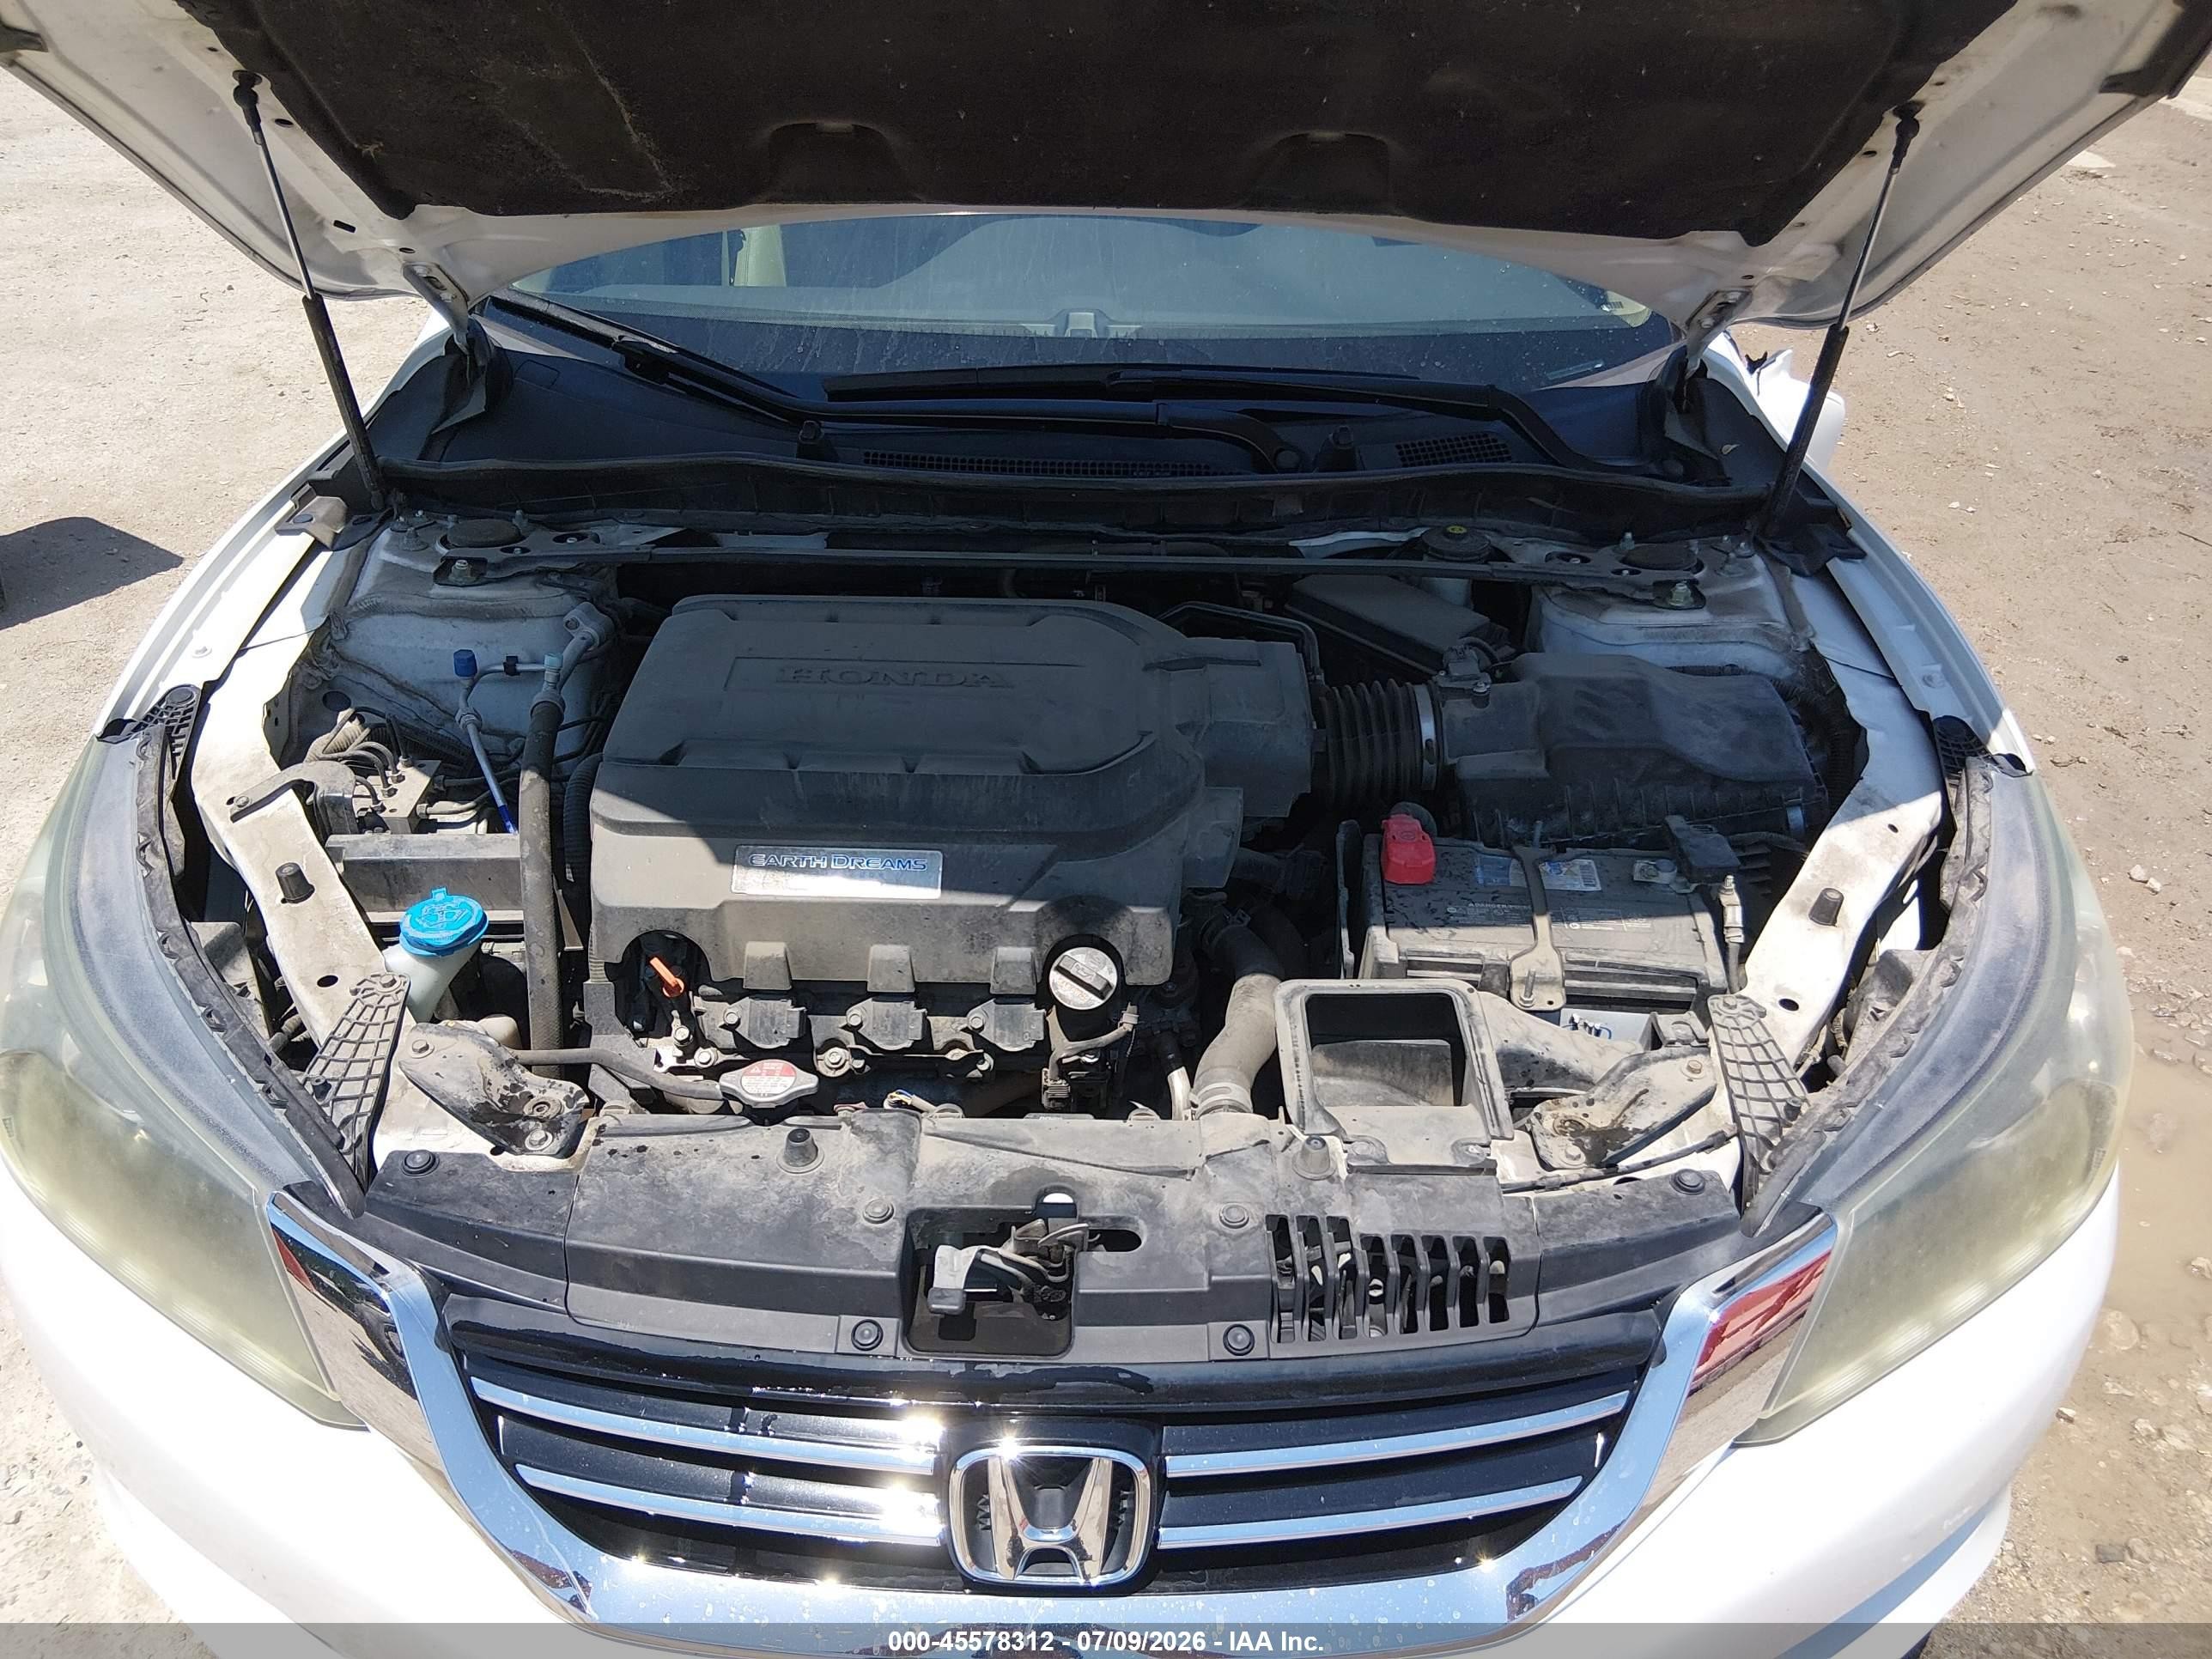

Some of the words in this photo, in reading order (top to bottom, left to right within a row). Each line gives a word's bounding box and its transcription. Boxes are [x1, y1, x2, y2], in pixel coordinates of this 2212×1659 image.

[775, 666, 1016, 689] HONDA
[748, 854, 827, 869] EARTH
[830, 854, 928, 872] DREAMS
